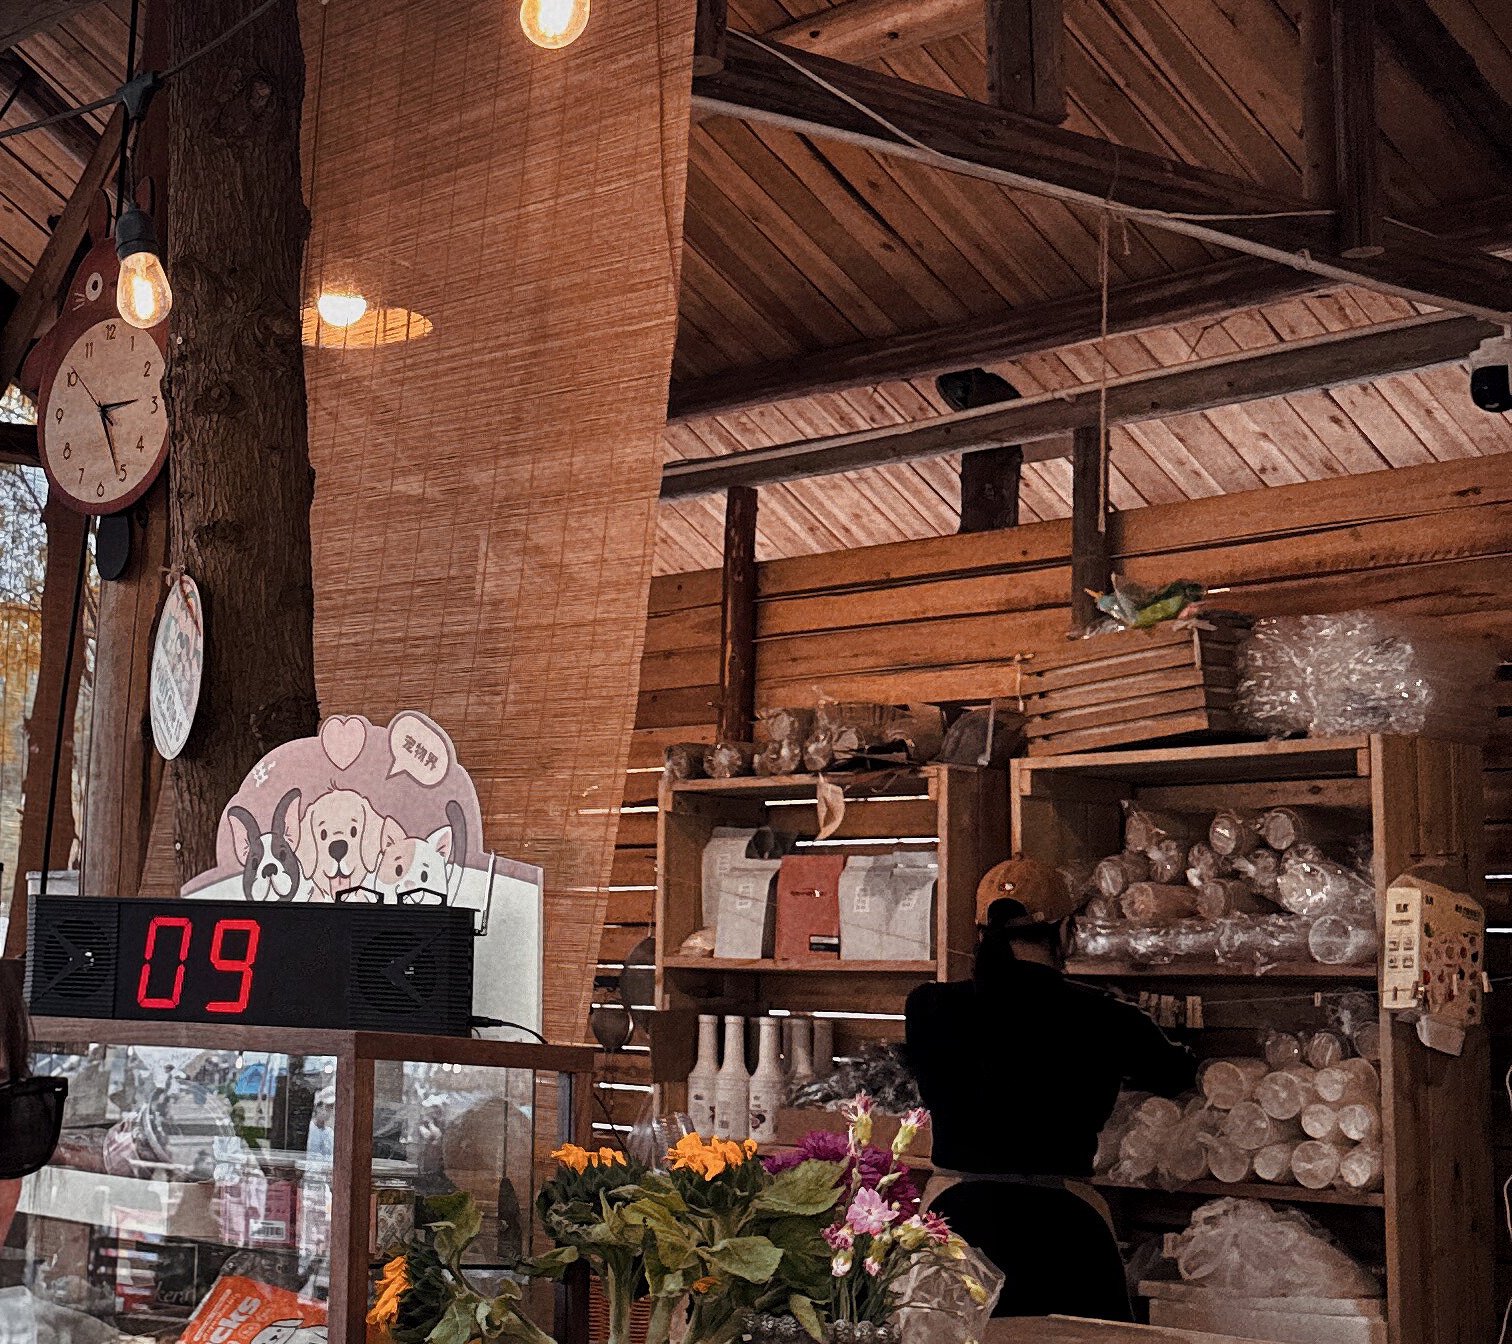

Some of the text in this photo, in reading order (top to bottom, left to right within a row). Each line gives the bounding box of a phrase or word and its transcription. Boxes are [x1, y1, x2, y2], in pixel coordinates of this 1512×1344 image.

[105, 323, 117, 341] 12
[85, 342, 94, 359] 11
[143, 360, 152, 378] 2
[66, 370, 79, 388] 10
[150, 395, 159, 415] 3
[55, 407, 64, 425] 9
[62, 441, 73, 461] 8
[135, 435, 145, 453] 4
[78, 467, 85, 485] 7
[118, 463, 128, 483] 5
[96, 482, 105, 498] 6
[137, 916, 261, 1014] 09
